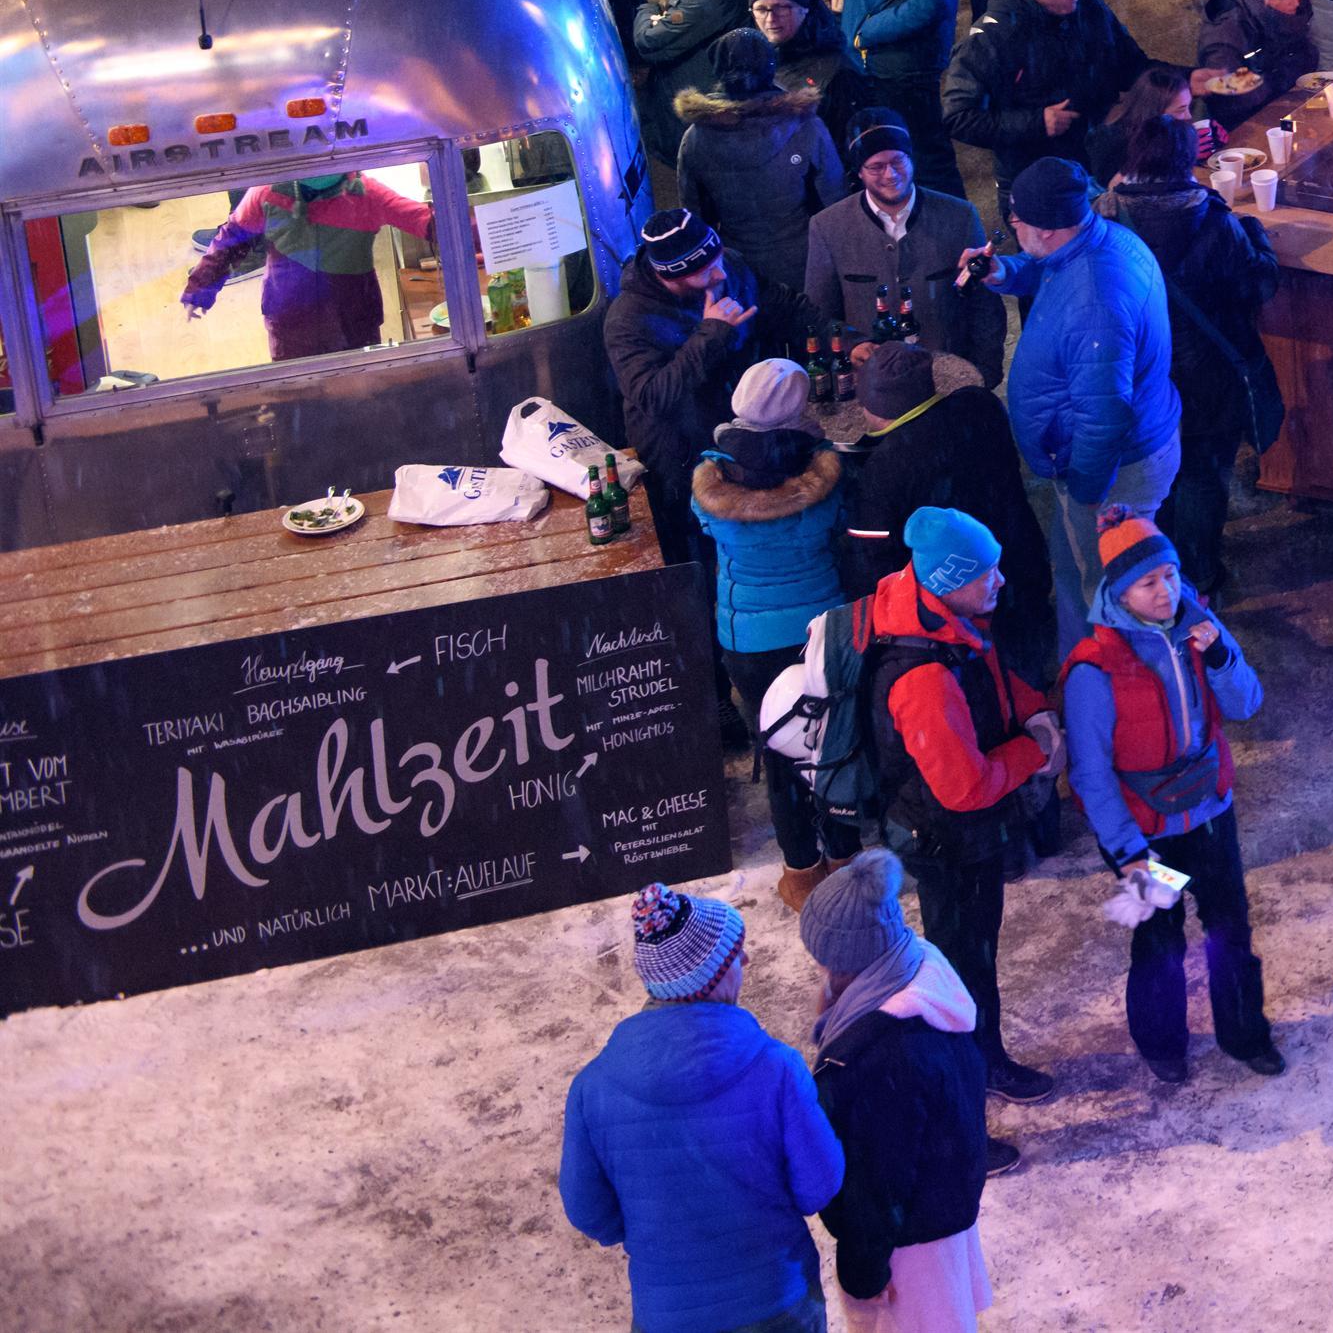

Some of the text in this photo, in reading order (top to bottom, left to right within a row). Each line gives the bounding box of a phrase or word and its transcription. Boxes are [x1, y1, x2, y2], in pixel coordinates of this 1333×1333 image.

[77, 117, 369, 180] AIRSTREAM
[434, 623, 508, 666] FISCH
[585, 621, 671, 658] Nachtisch
[607, 677, 680, 708] STRUDEL
[142, 686, 368, 746] TERIYAKI BACHSAIBLING
[585, 721, 603, 733] MIT
[187, 744, 205, 756] MIT
[601, 721, 675, 753] HONIGMUS
[28, 754, 68, 782] VOM
[77, 658, 576, 931] Mahlzeit
[508, 770, 577, 811] HONIG
[602, 789, 708, 829] MAC & CHEESE
[614, 825, 706, 853] PETERSILIENSALAT
[641, 822, 659, 832] MIT
[258, 902, 351, 939] NATÜRLICH
